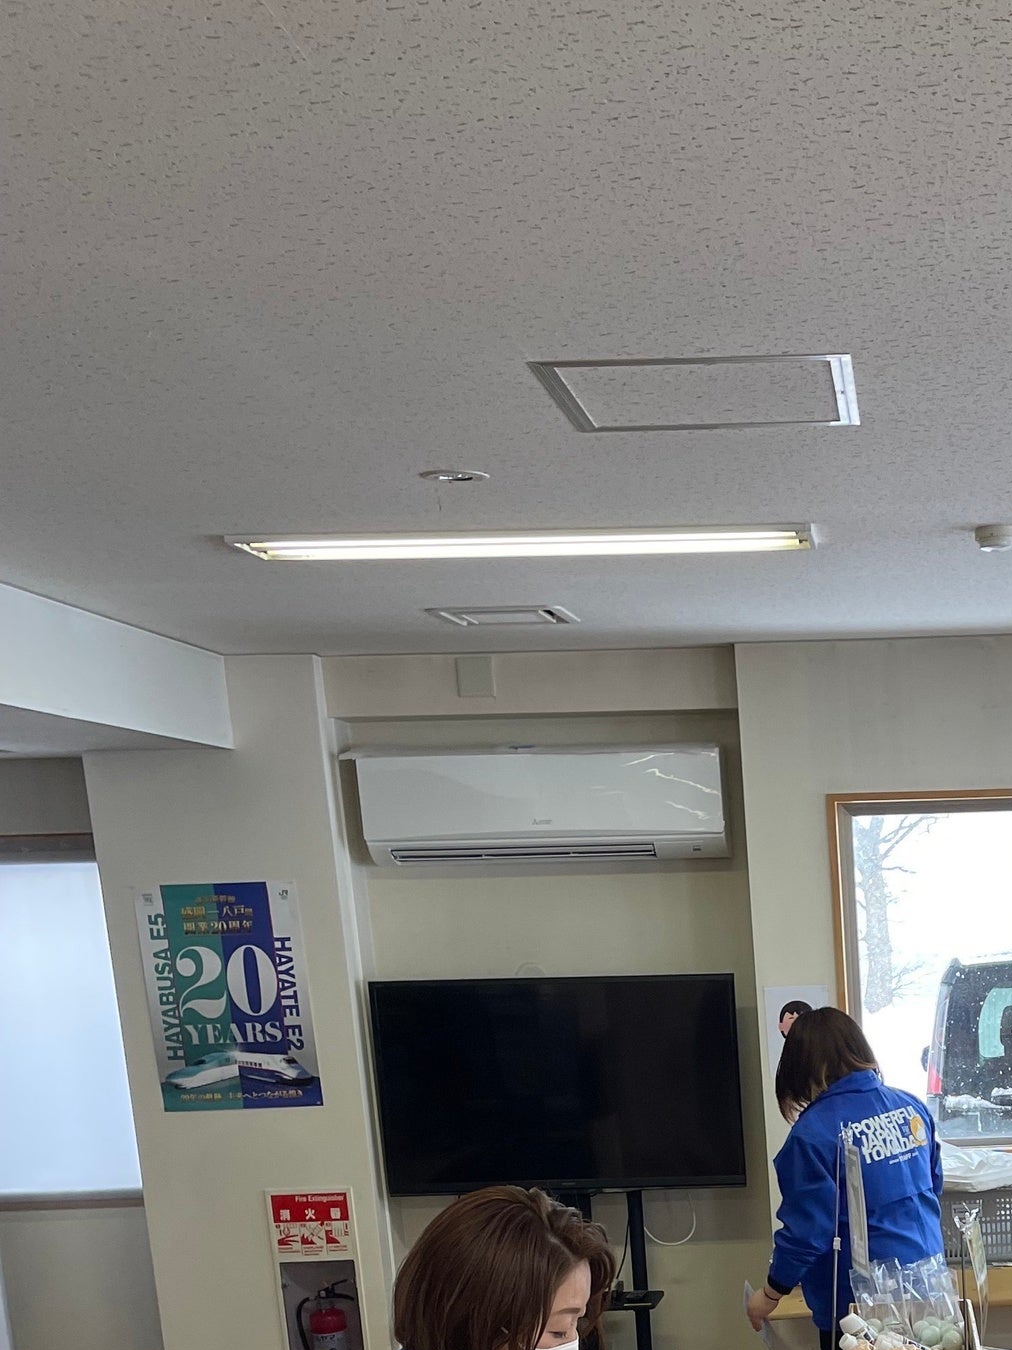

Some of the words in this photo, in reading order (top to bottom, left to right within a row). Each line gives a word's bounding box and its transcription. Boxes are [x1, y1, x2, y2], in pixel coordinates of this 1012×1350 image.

[147, 913, 169, 941] E5
[175, 944, 278, 1019] 20
[275, 936, 301, 1017] HAYATE
[150, 947, 184, 1061] HAYABUSA
[183, 1021, 283, 1046] YEARS
[285, 1024, 304, 1051] E2
[851, 1105, 916, 1138] POWERFUL
